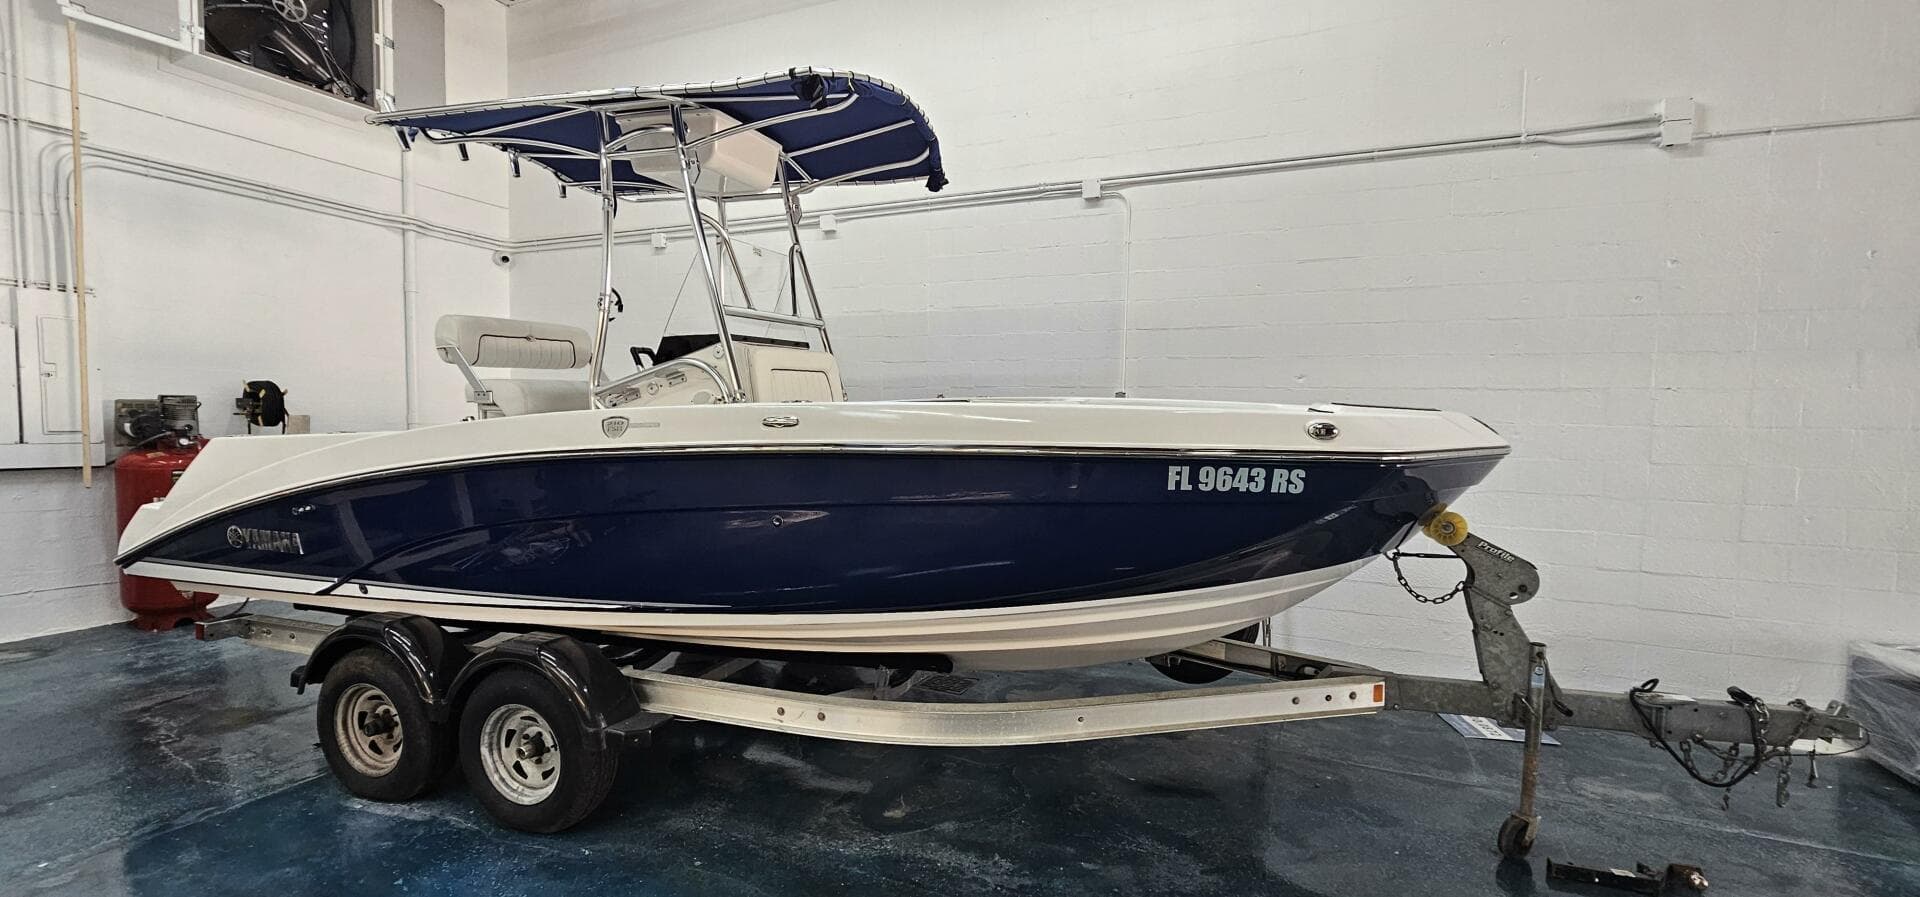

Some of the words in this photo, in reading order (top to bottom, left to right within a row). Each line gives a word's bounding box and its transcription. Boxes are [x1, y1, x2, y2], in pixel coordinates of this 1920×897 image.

[1167, 465, 1193, 491] FL
[1198, 465, 1267, 493] 9643
[1270, 468, 1306, 494] RS
[241, 527, 304, 555] YAMAHA
[1475, 541, 1515, 563] Profile
